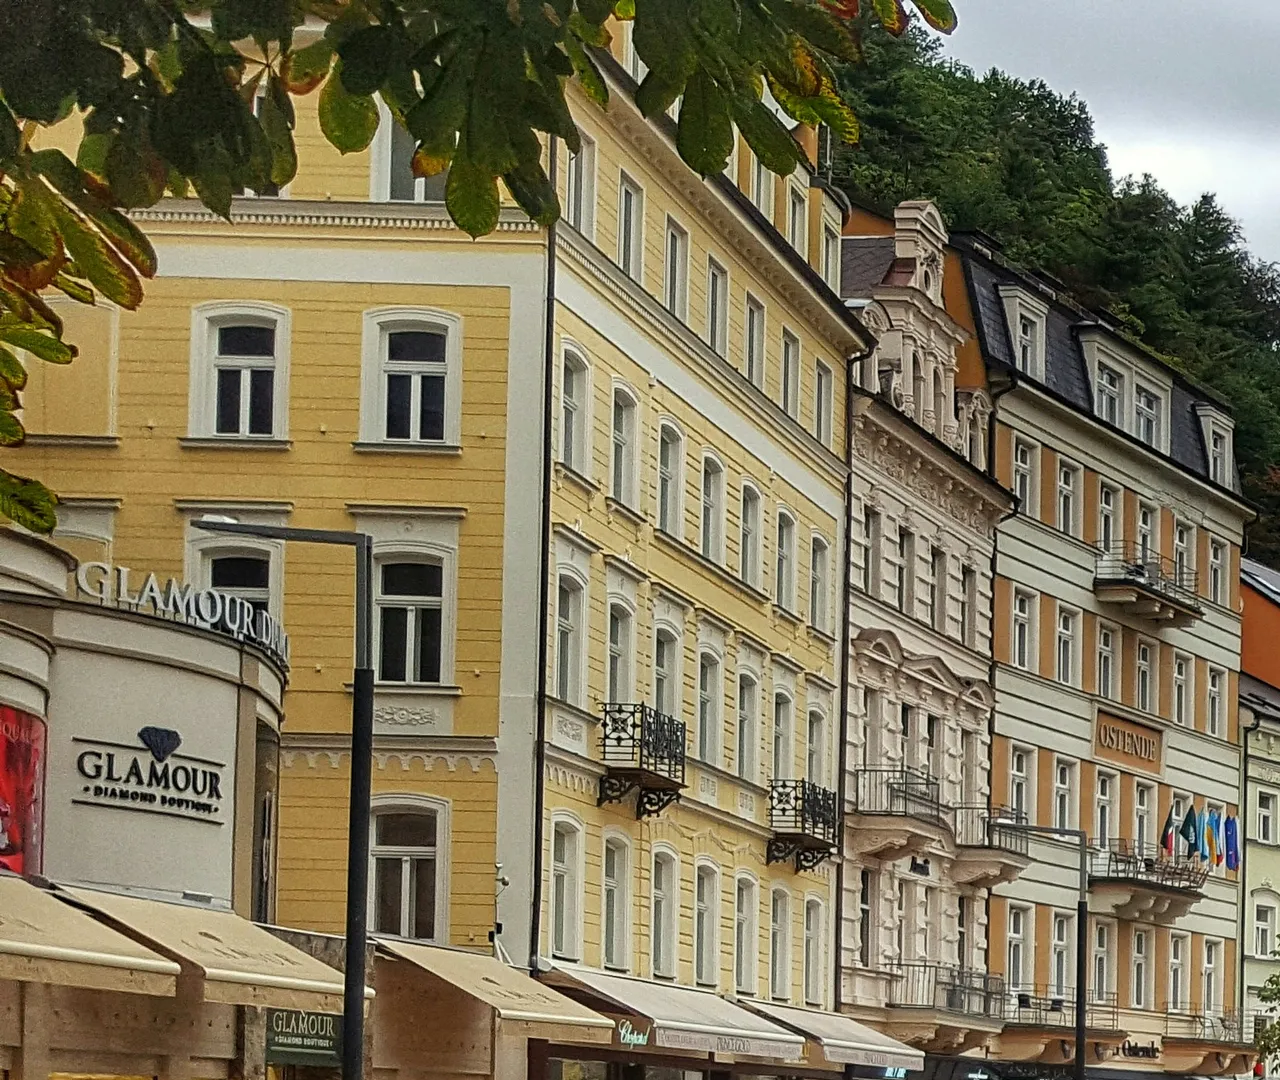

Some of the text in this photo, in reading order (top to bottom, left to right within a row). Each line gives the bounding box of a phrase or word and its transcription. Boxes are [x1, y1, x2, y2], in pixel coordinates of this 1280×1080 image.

[77, 562, 257, 639] GLAMOUR
[1100, 723, 1157, 762] OSTENDE
[77, 751, 223, 800] GLAMOUR
[93, 786, 214, 814] DIAMOND BOUTIQUE
[273, 1011, 335, 1037] GLAMOUR
[278, 1035, 329, 1047] DIAMOND BOUTIQUE
